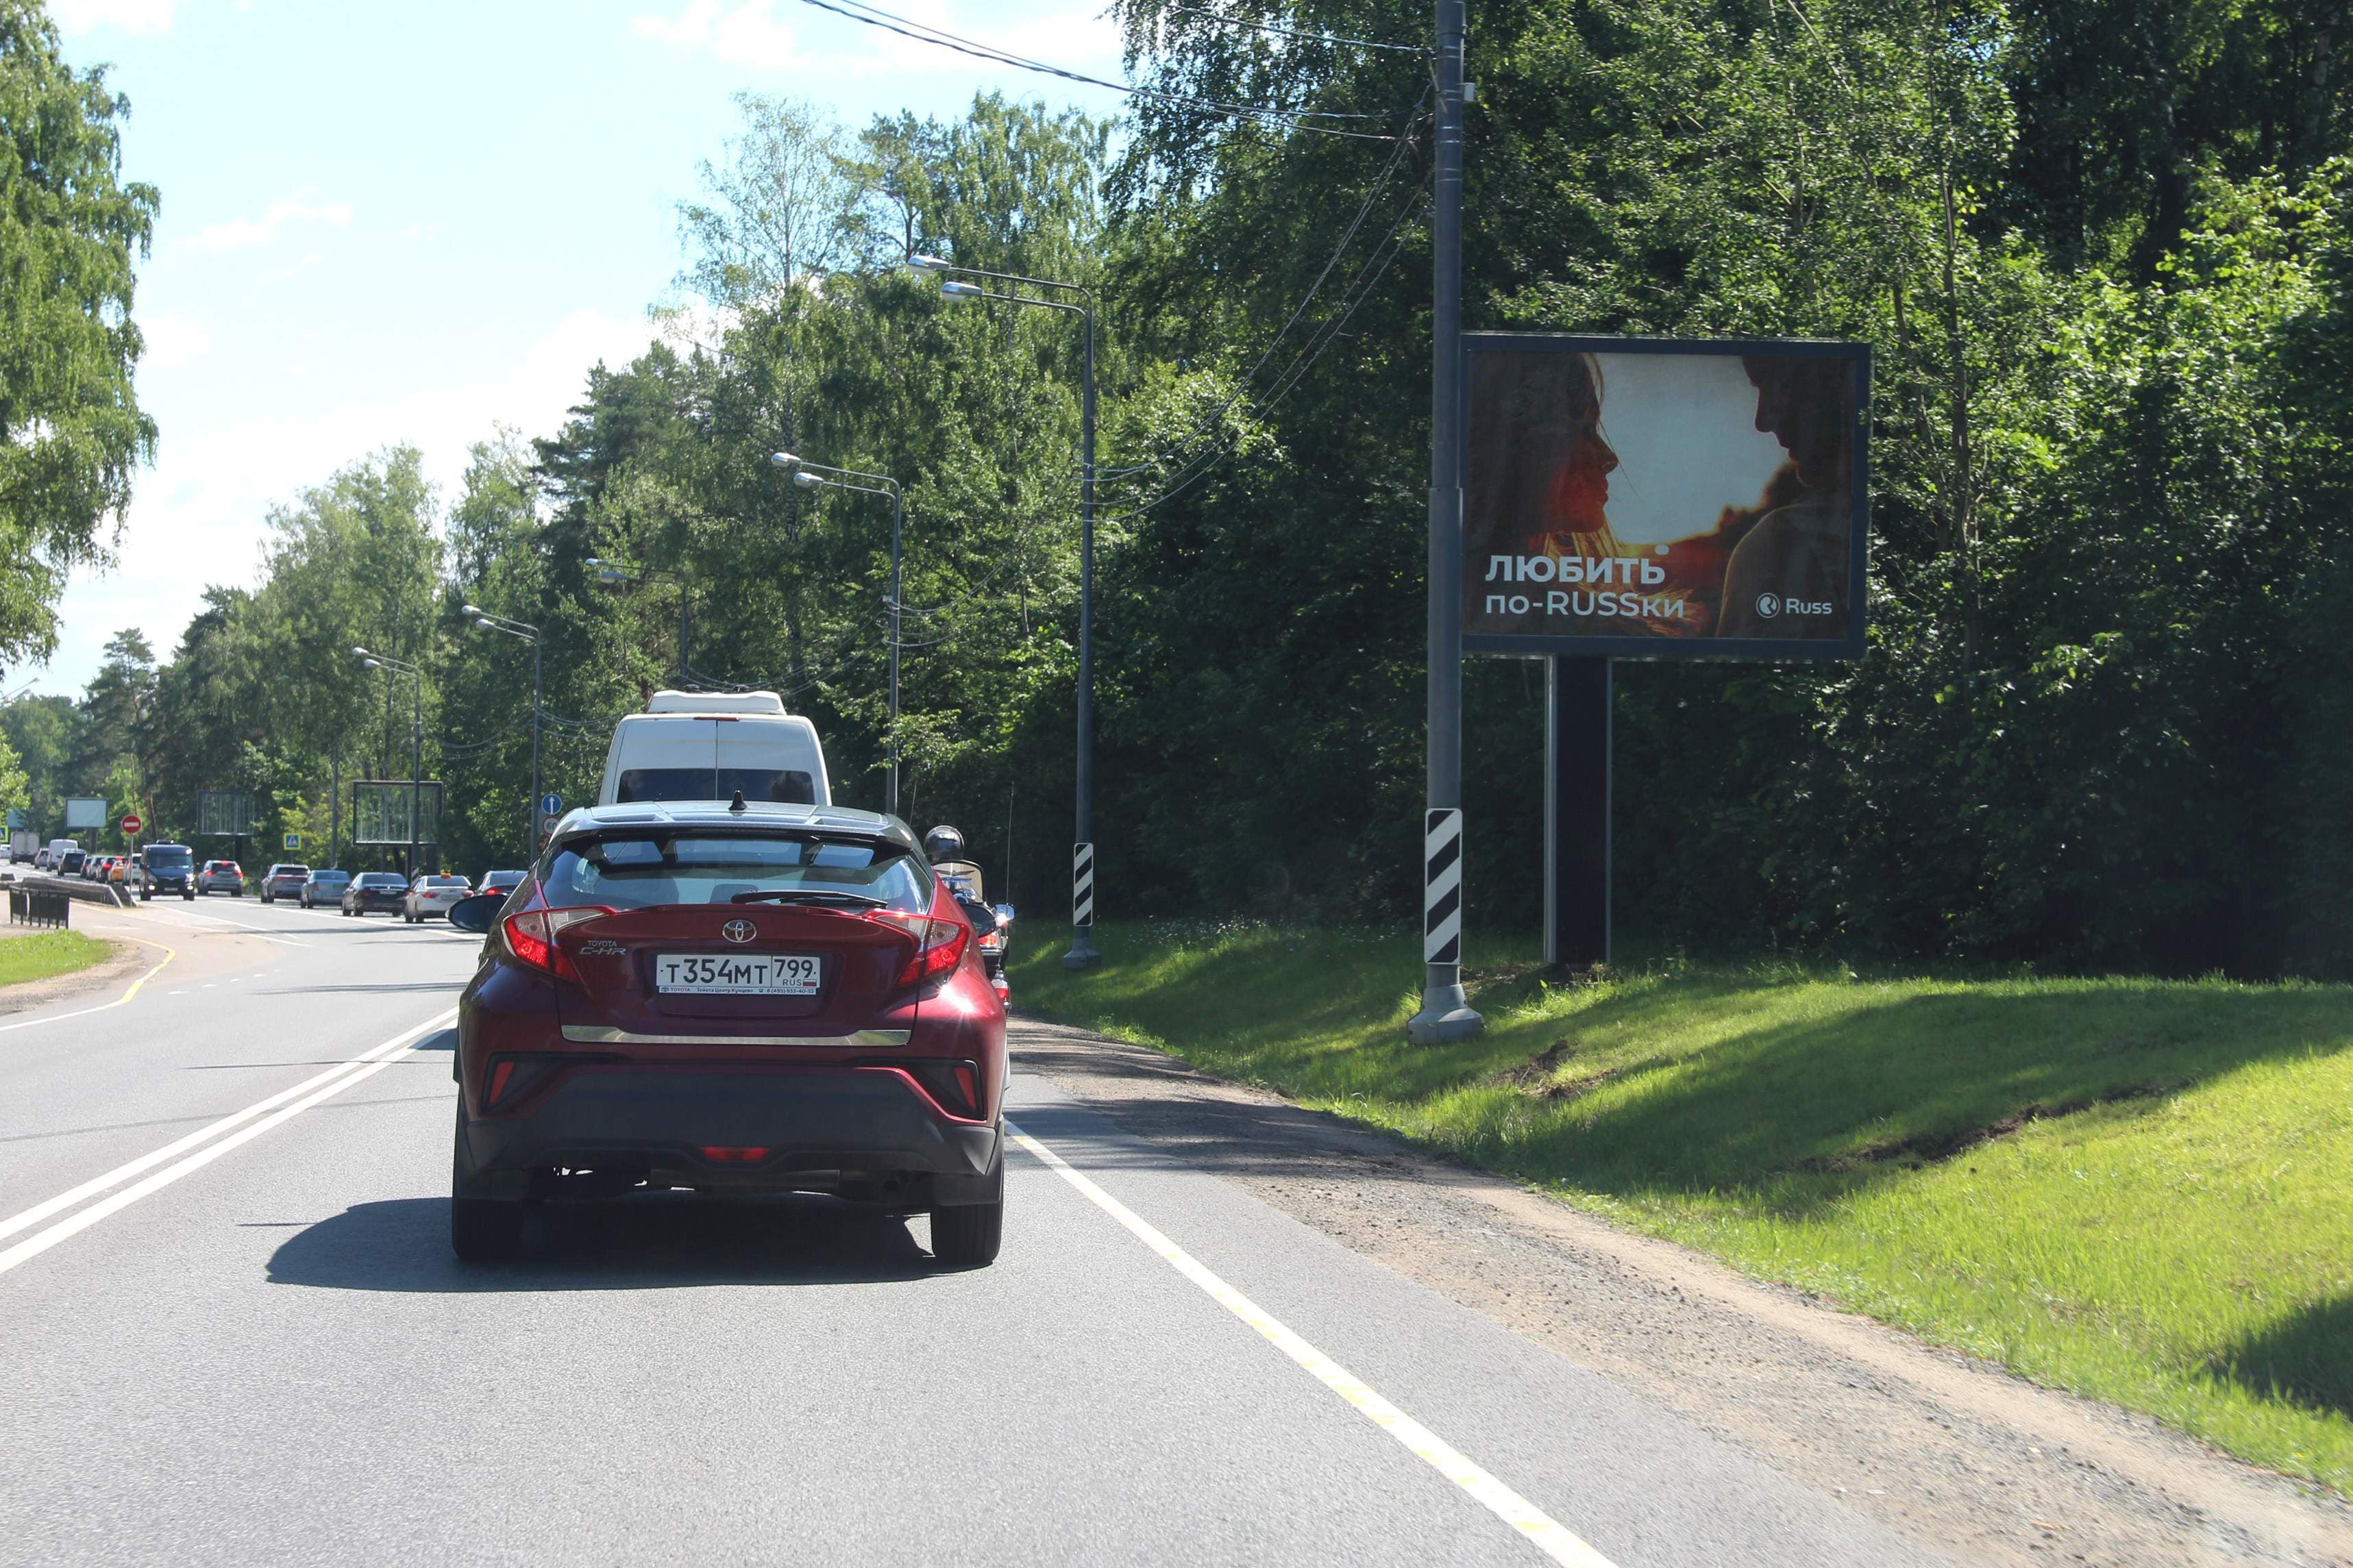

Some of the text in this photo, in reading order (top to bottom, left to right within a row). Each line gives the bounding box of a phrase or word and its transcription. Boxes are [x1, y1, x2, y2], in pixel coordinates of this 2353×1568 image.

[1485, 555, 1666, 584] ЛЮБИТЬ
[1486, 590, 1684, 617] по-RUSSки
[1786, 598, 1832, 614] Russ
[580, 947, 626, 955] C-HR
[774, 959, 813, 978] 799
